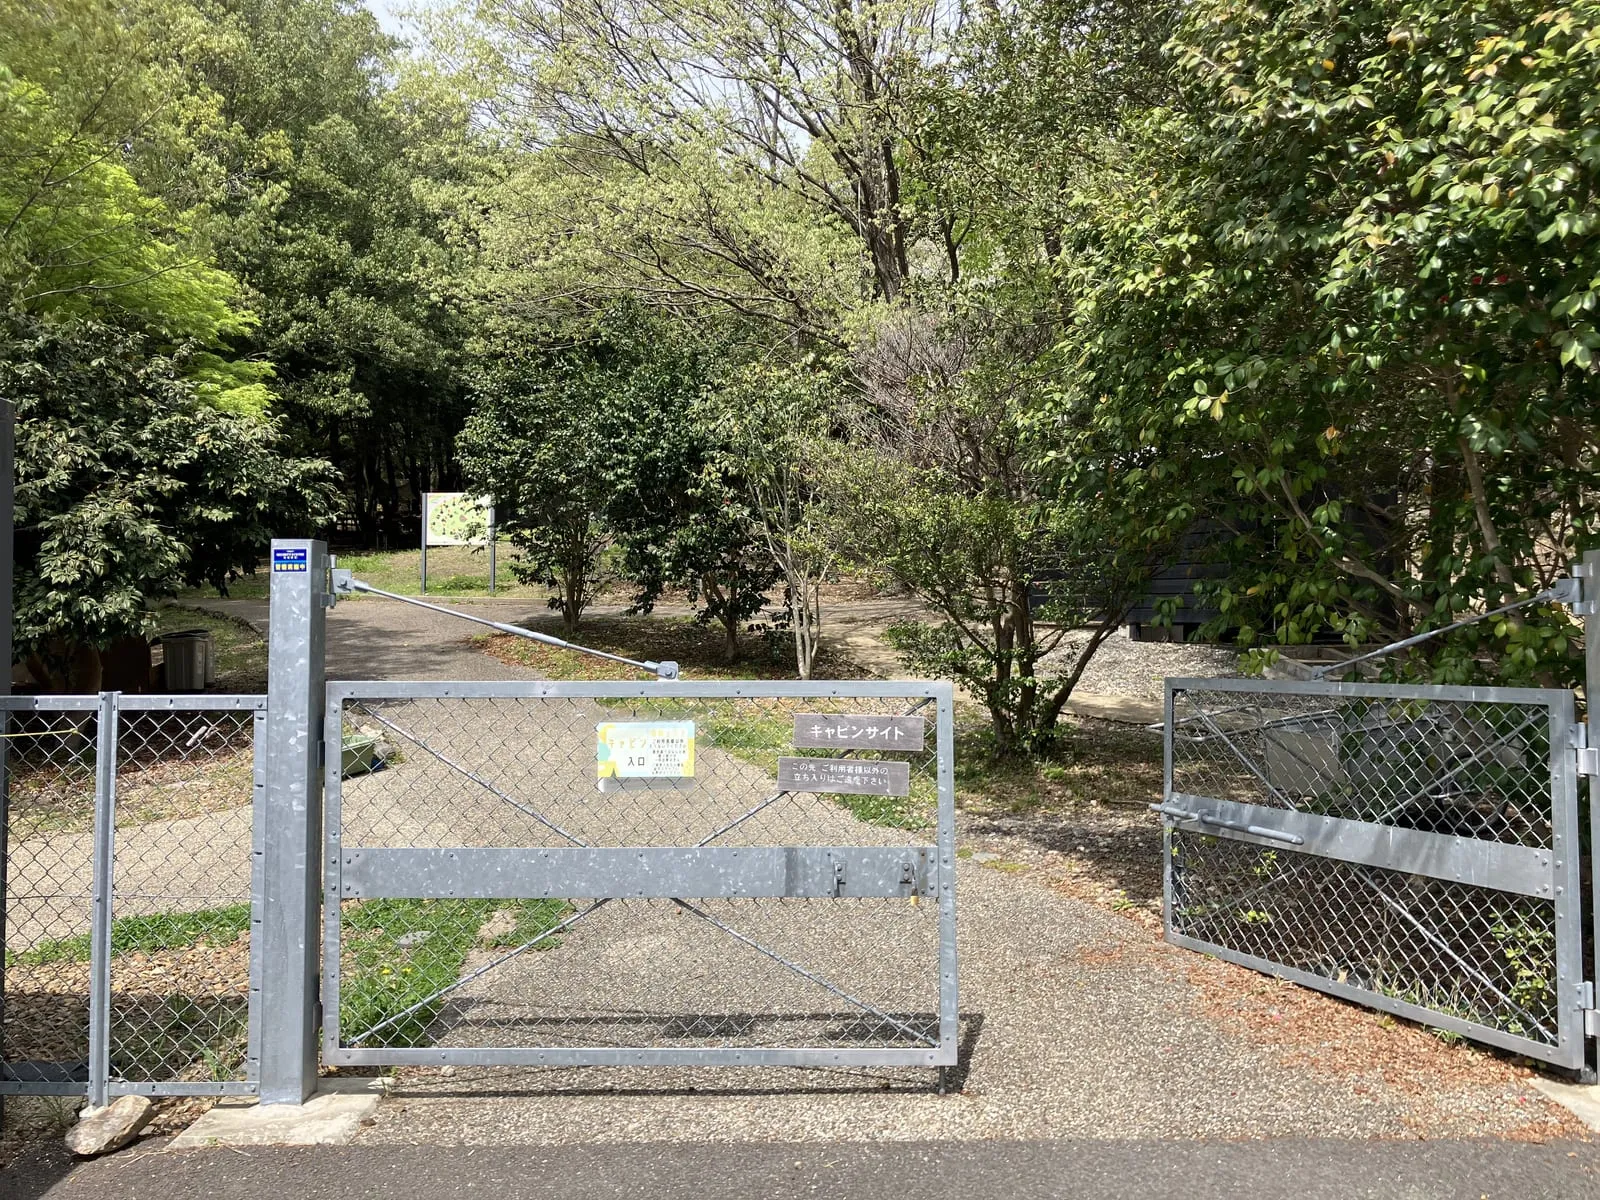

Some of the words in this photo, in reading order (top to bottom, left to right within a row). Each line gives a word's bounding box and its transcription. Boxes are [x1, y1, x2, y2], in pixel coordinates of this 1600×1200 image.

[810, 724, 905, 740] キャビンサイト
[627, 756, 645, 767] 入口
[792, 762, 817, 772] この先
